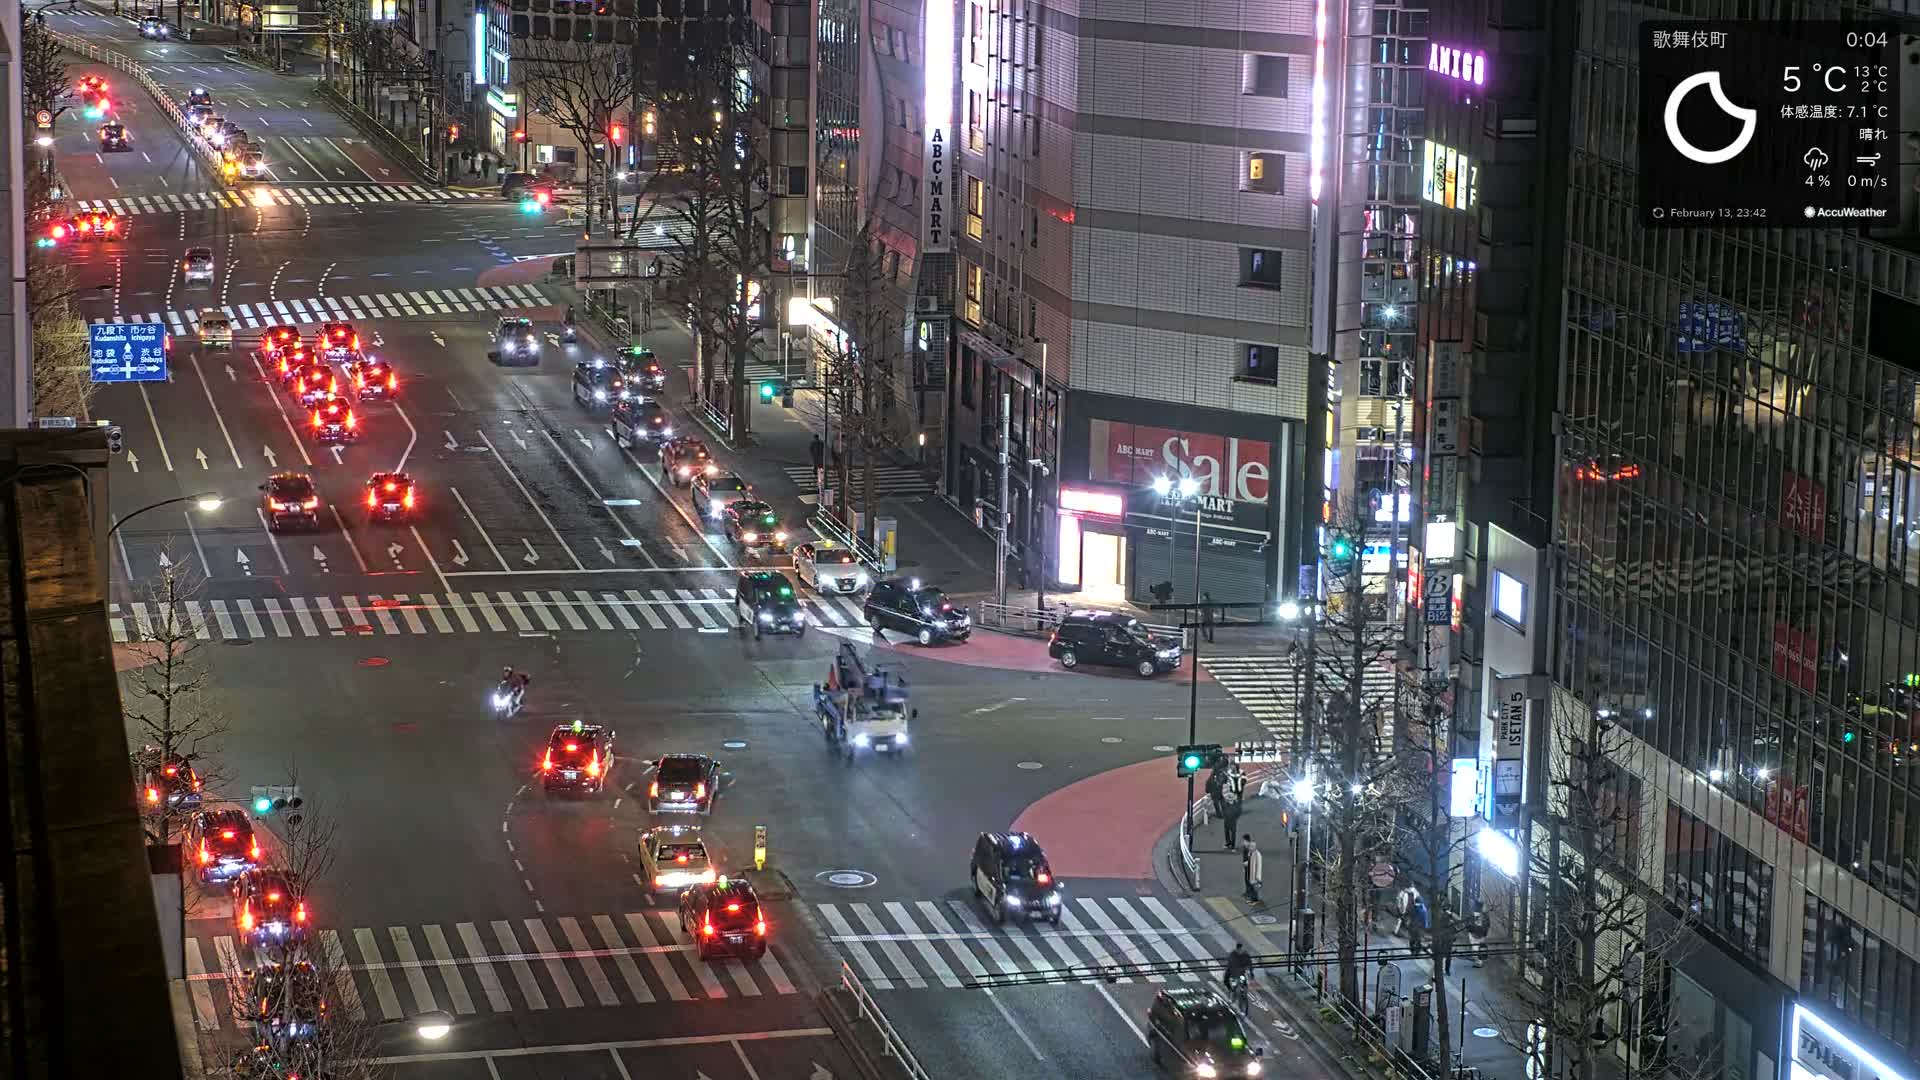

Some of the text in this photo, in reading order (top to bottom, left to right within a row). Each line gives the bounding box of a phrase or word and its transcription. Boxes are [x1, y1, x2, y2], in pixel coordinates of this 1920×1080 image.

[1428, 43, 1484, 86] AMIGO
[96, 326, 125, 335] 九段下
[1162, 436, 1270, 506] Sale
[1509, 692, 1522, 746] ISETAN 5
